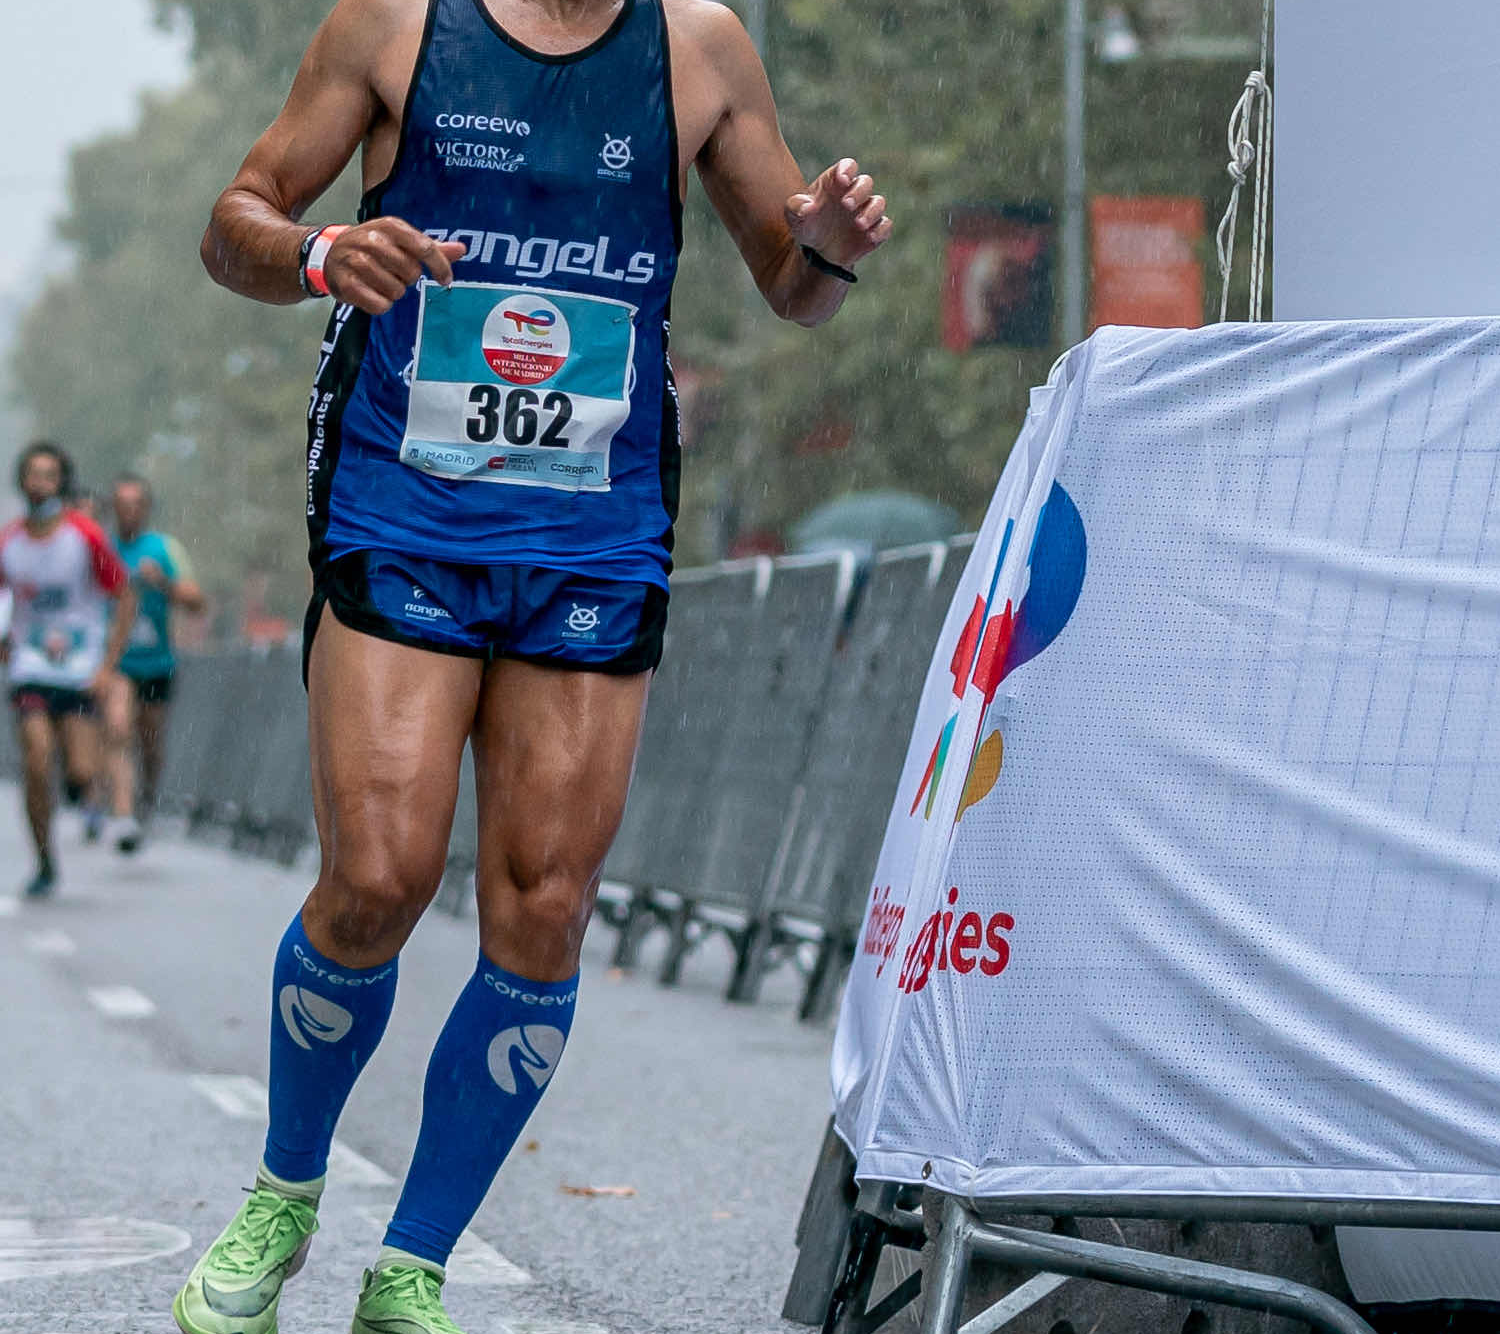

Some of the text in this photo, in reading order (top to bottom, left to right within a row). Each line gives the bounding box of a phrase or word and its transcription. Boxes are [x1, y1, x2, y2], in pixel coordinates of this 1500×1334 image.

[435, 141, 511, 161] VICTORY
[445, 156, 519, 172] ENDURANCE
[466, 384, 574, 449] 362
[425, 451, 476, 467] MADRID
